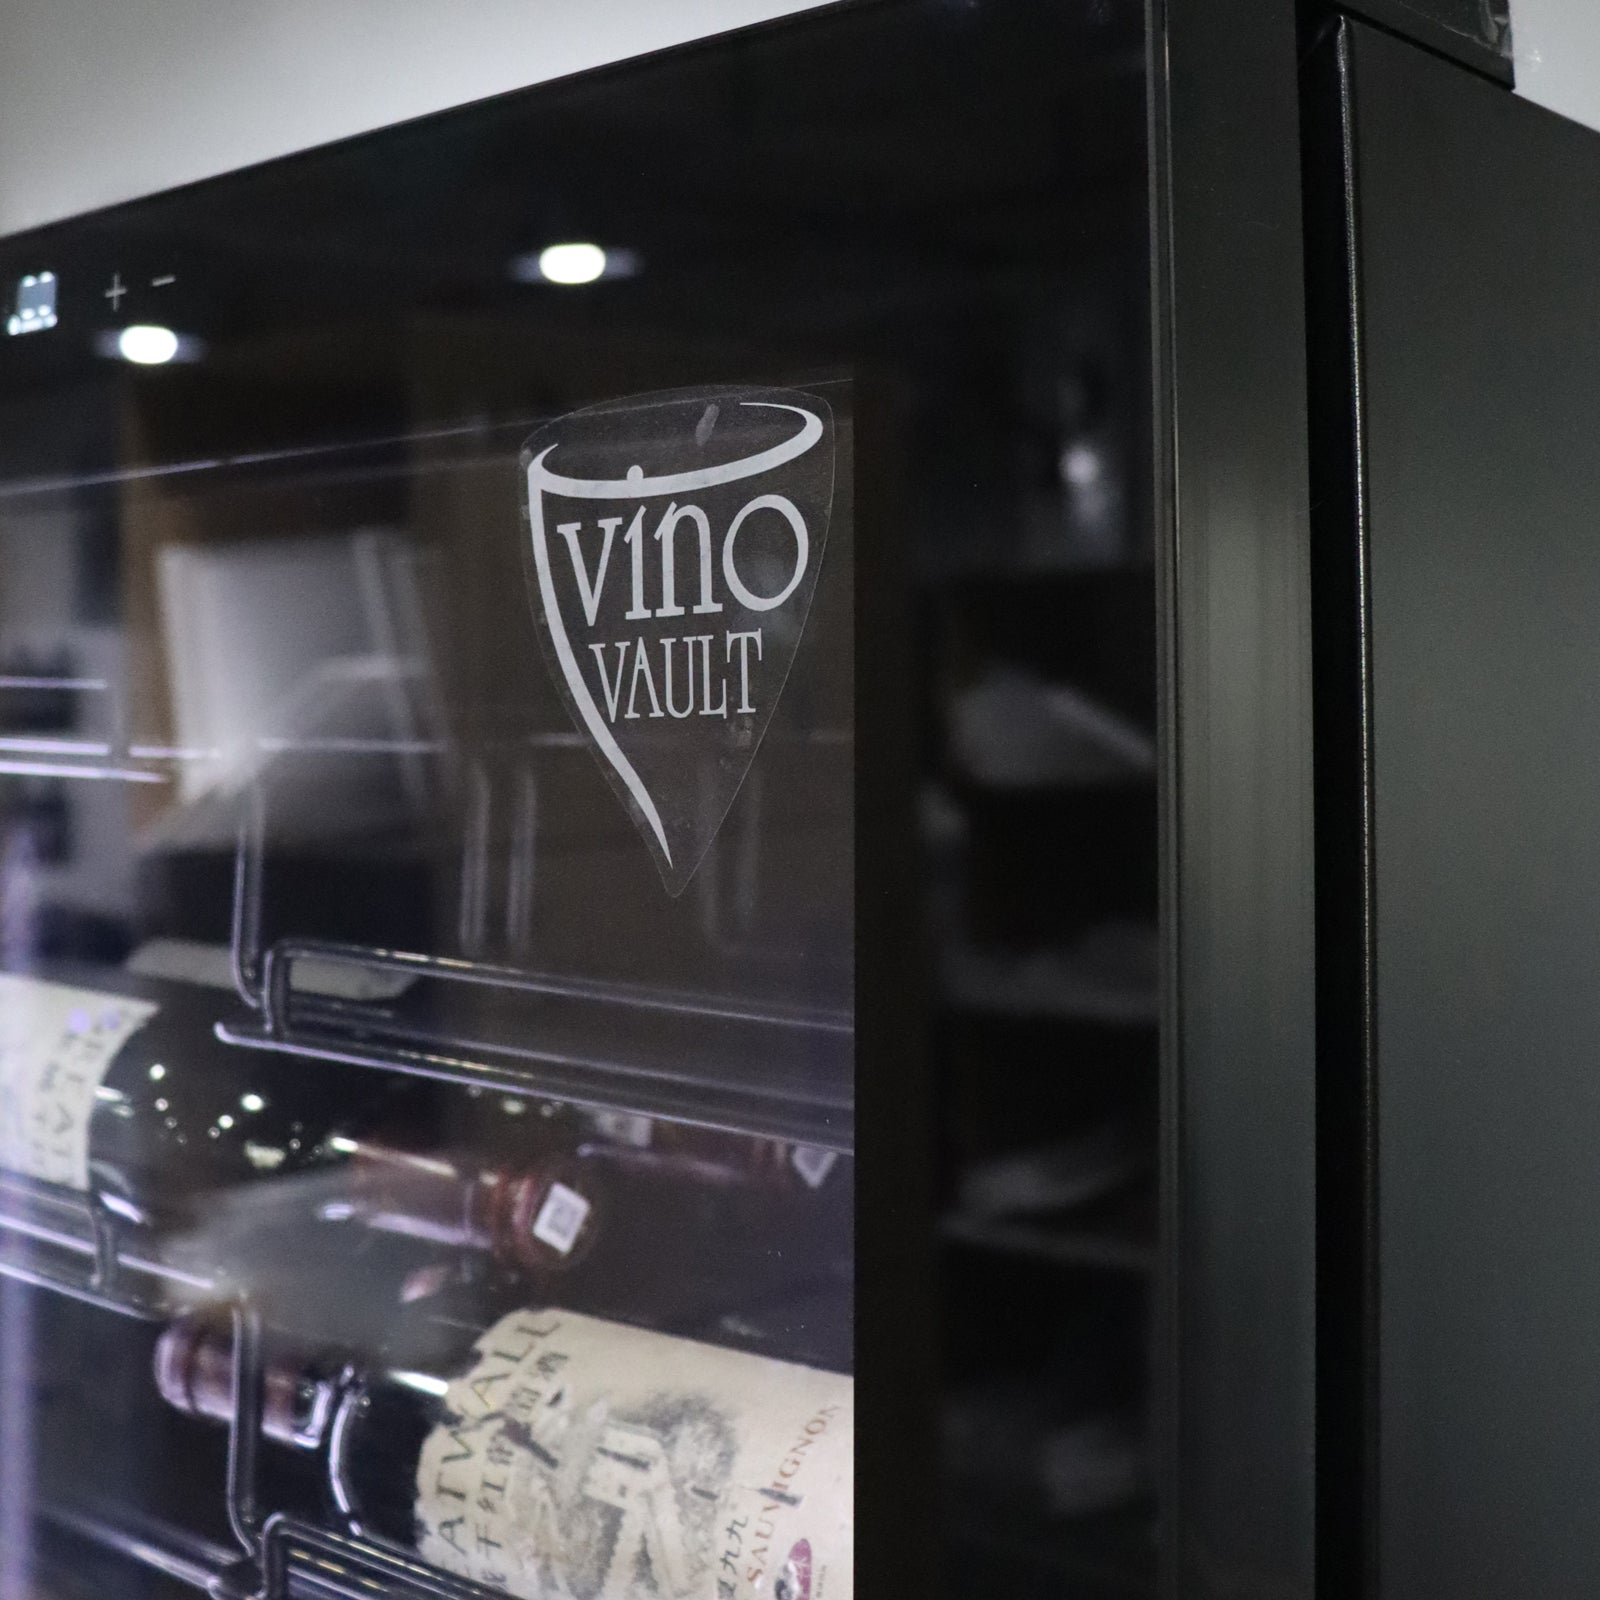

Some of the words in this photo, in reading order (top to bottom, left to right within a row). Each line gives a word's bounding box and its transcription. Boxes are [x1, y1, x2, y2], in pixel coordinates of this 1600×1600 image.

[588, 627, 762, 723] VAULT
[440, 1321, 561, 1463] WALL
[746, 1405, 841, 1582] SAUVIGNON
